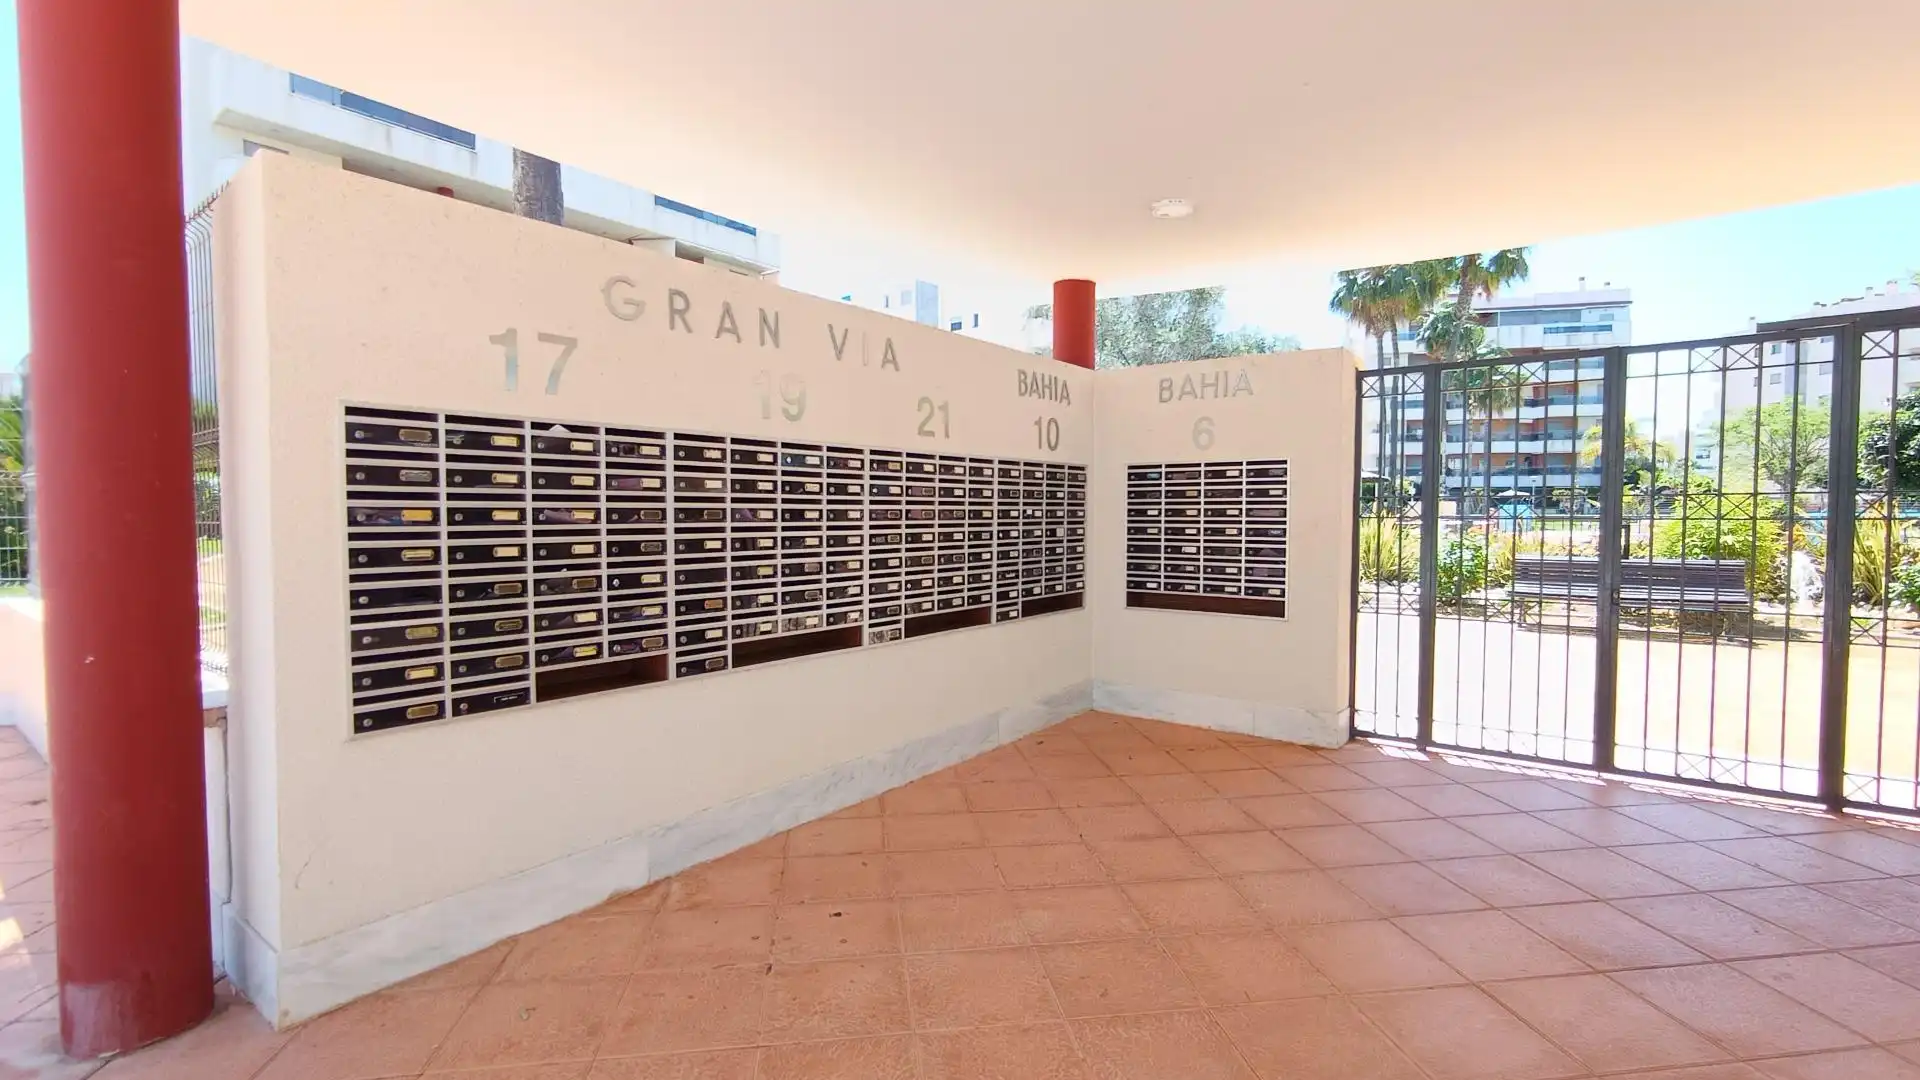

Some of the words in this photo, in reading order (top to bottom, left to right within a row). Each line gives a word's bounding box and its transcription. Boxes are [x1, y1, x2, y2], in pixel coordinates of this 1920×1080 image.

[601, 275, 781, 349] GRAN
[489, 328, 577, 396] 17
[754, 370, 808, 422] 19
[1017, 368, 1071, 406] BAHIA
[1158, 368, 1254, 403] BAHIA
[916, 396, 951, 440] 21
[1034, 416, 1060, 451] 10
[1192, 416, 1216, 451] 6
